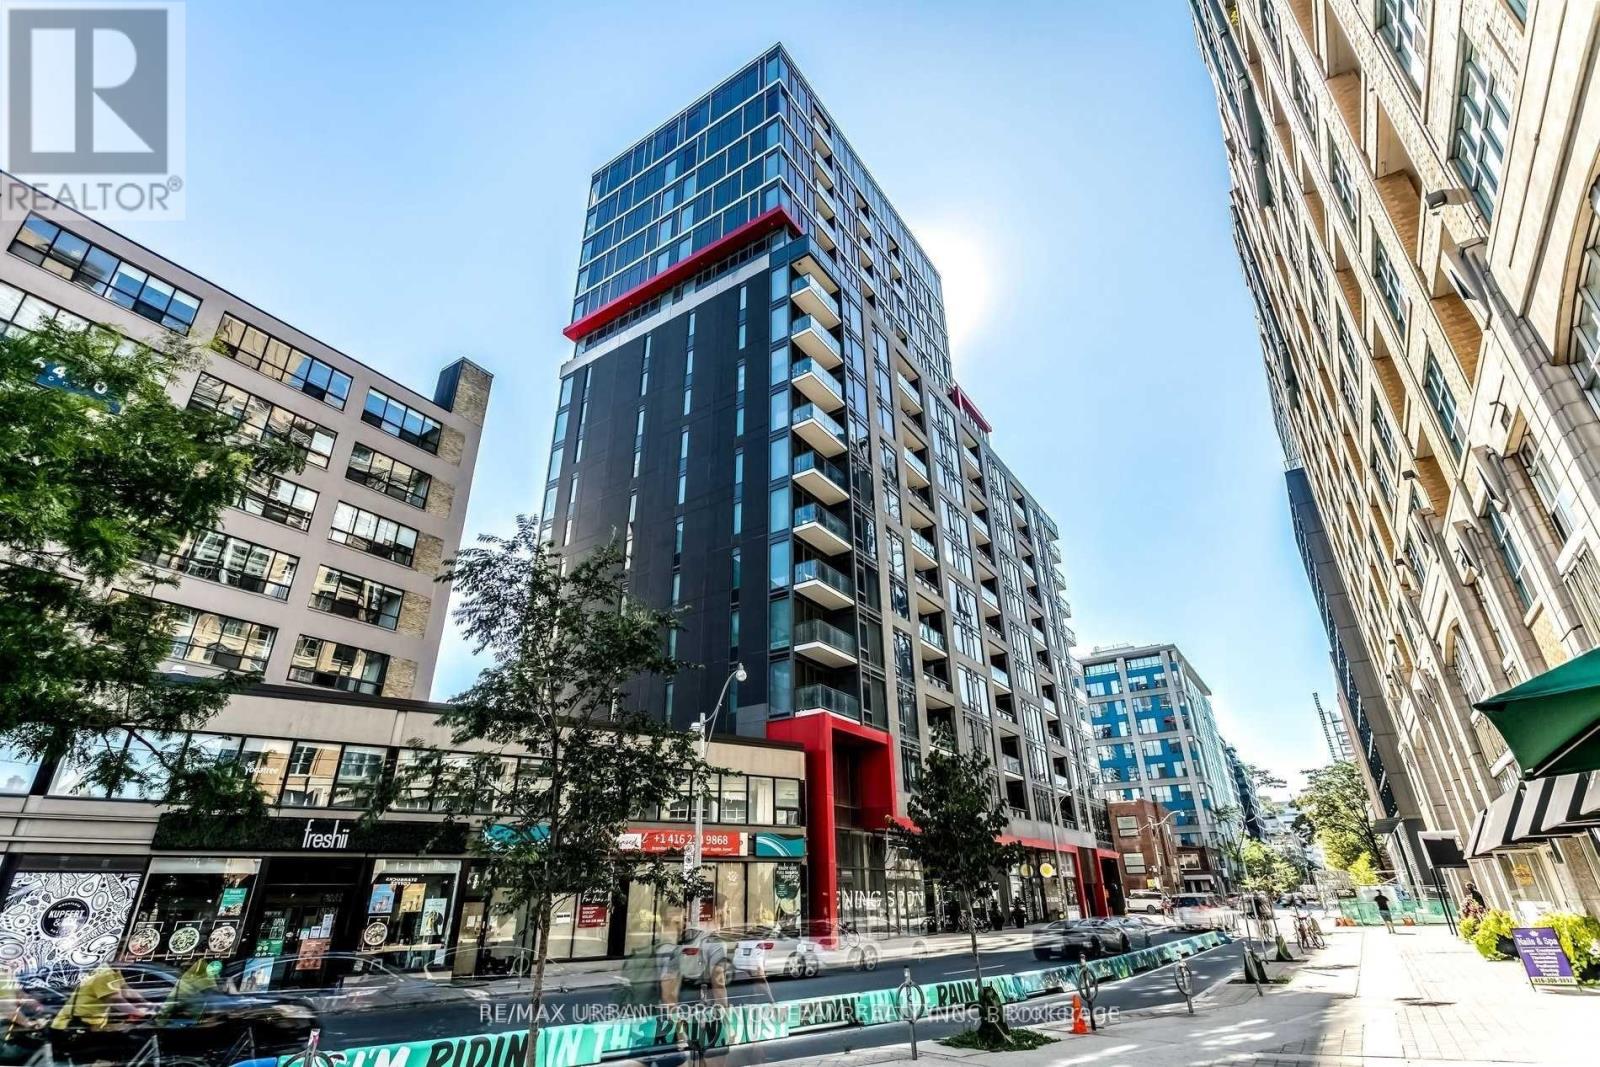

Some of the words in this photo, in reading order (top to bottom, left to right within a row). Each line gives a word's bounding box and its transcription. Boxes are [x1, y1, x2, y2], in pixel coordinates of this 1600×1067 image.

[302, 819, 350, 849] freshii
[654, 834, 666, 844] +1
[667, 834, 685, 844] 416
[706, 834, 729, 846] 9868
[887, 890, 925, 907] SOON
